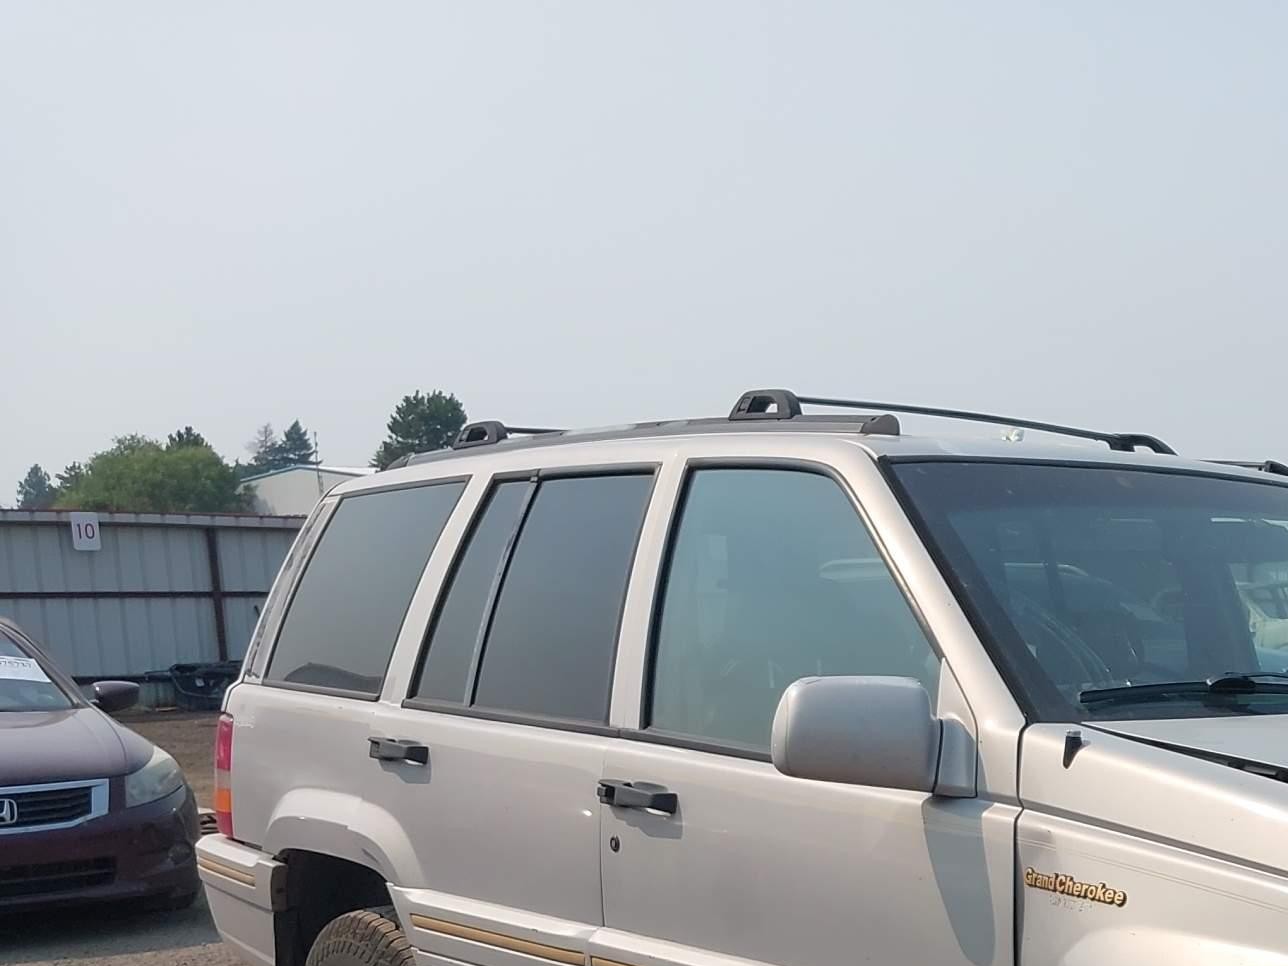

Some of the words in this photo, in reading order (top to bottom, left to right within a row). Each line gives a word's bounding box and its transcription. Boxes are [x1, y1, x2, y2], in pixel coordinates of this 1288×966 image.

[77, 523, 95, 540] 10
[1024, 867, 1057, 893] Grand
[1056, 874, 1128, 907] Cherokee
